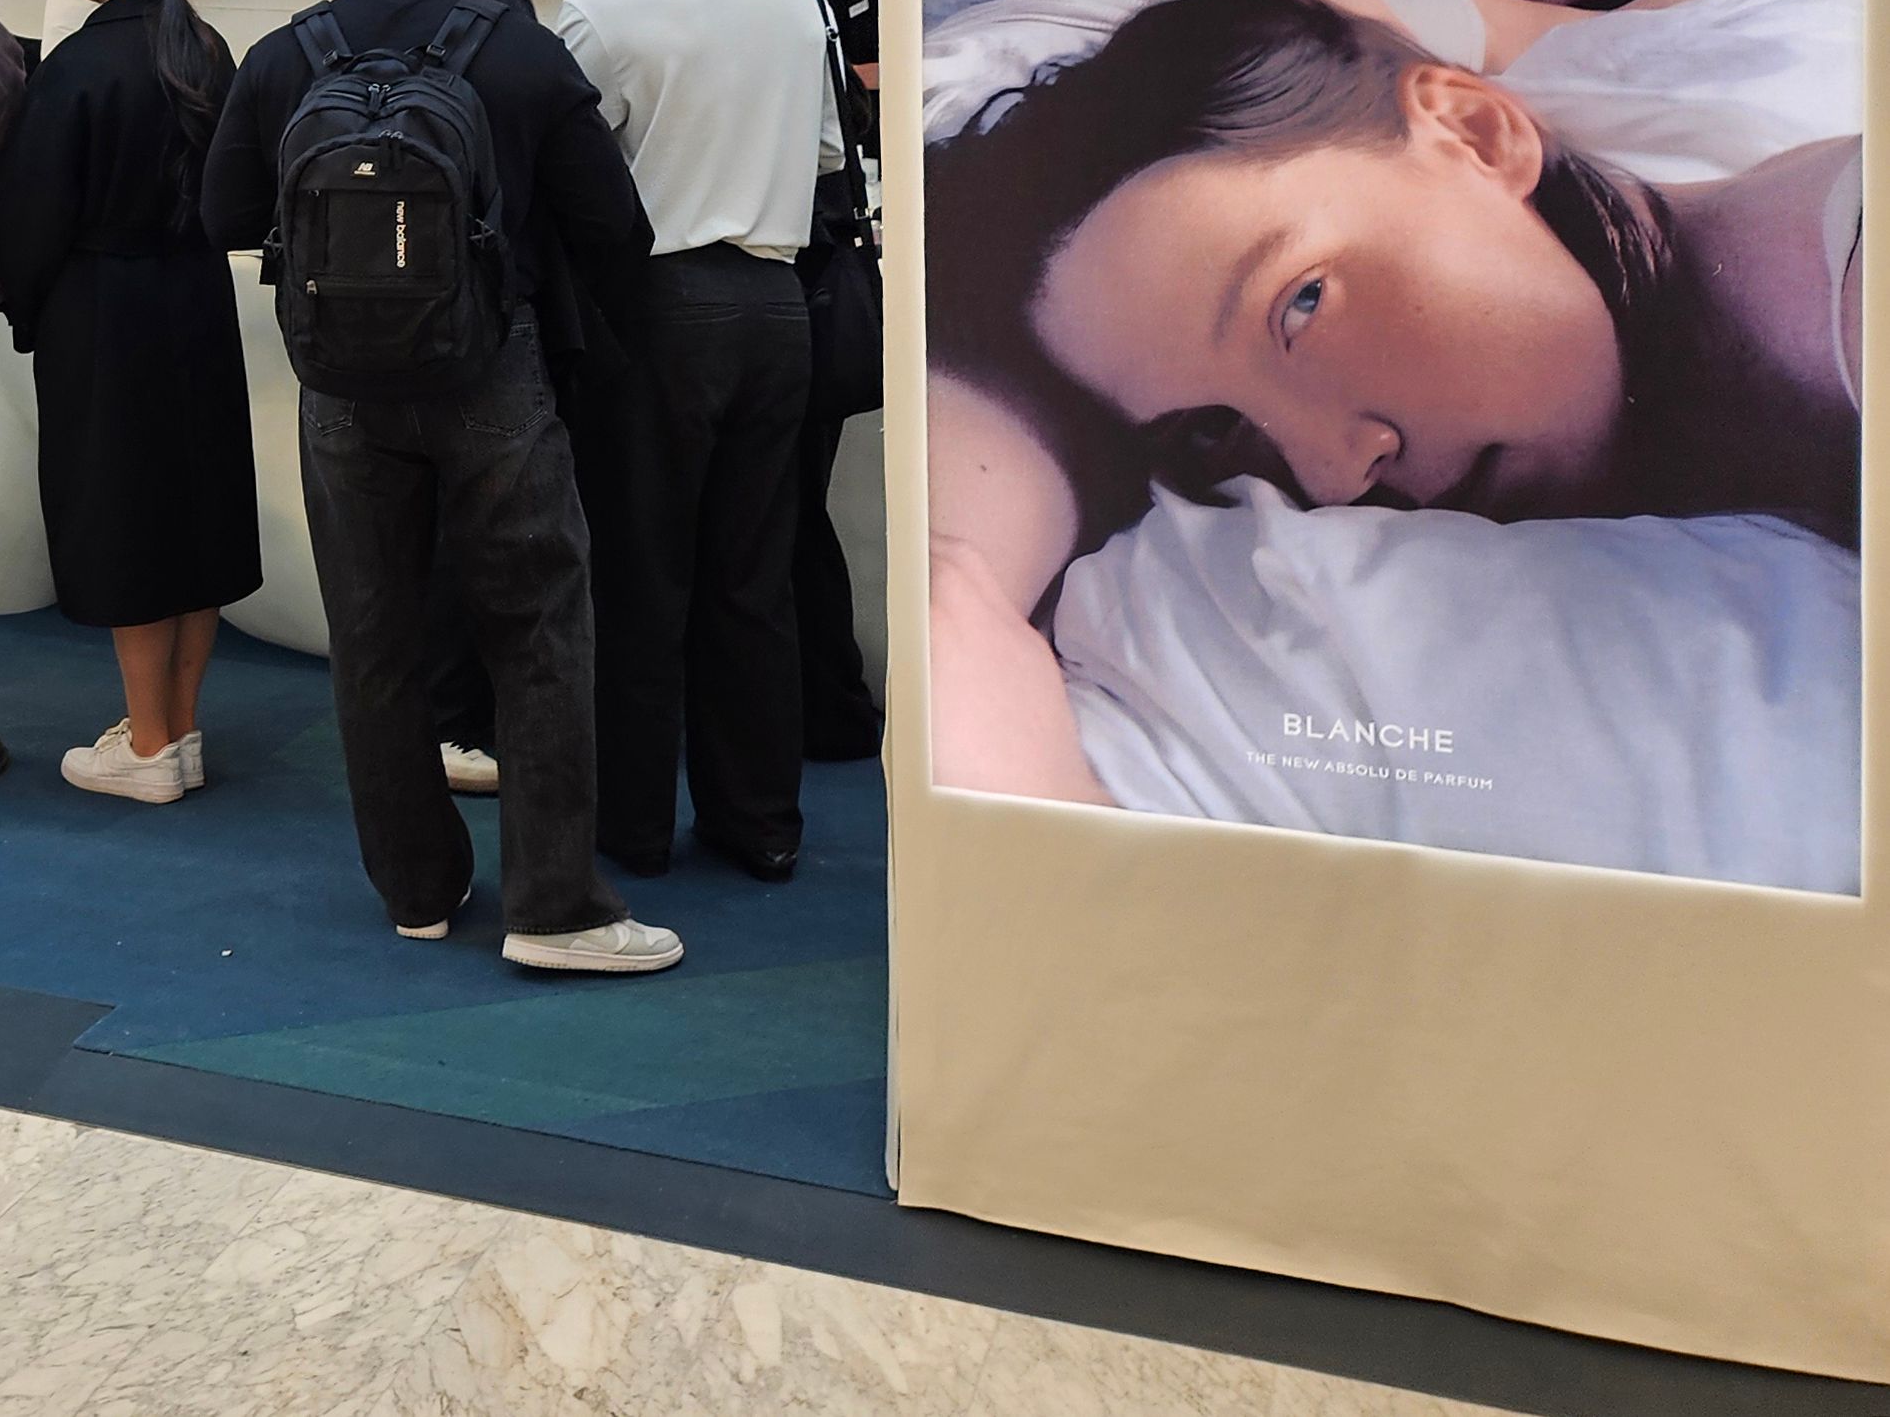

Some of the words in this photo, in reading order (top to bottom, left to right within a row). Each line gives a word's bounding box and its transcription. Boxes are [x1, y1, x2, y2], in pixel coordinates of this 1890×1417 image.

[396, 201, 405, 223] new
[396, 224, 407, 268] balance
[1283, 712, 1454, 754] BLANCHE
[1246, 751, 1276, 766] THE
[1282, 756, 1320, 771] NEW
[1324, 760, 1390, 779] ABSOLU
[1395, 768, 1418, 782] DE
[1423, 771, 1494, 791] PARFUM
